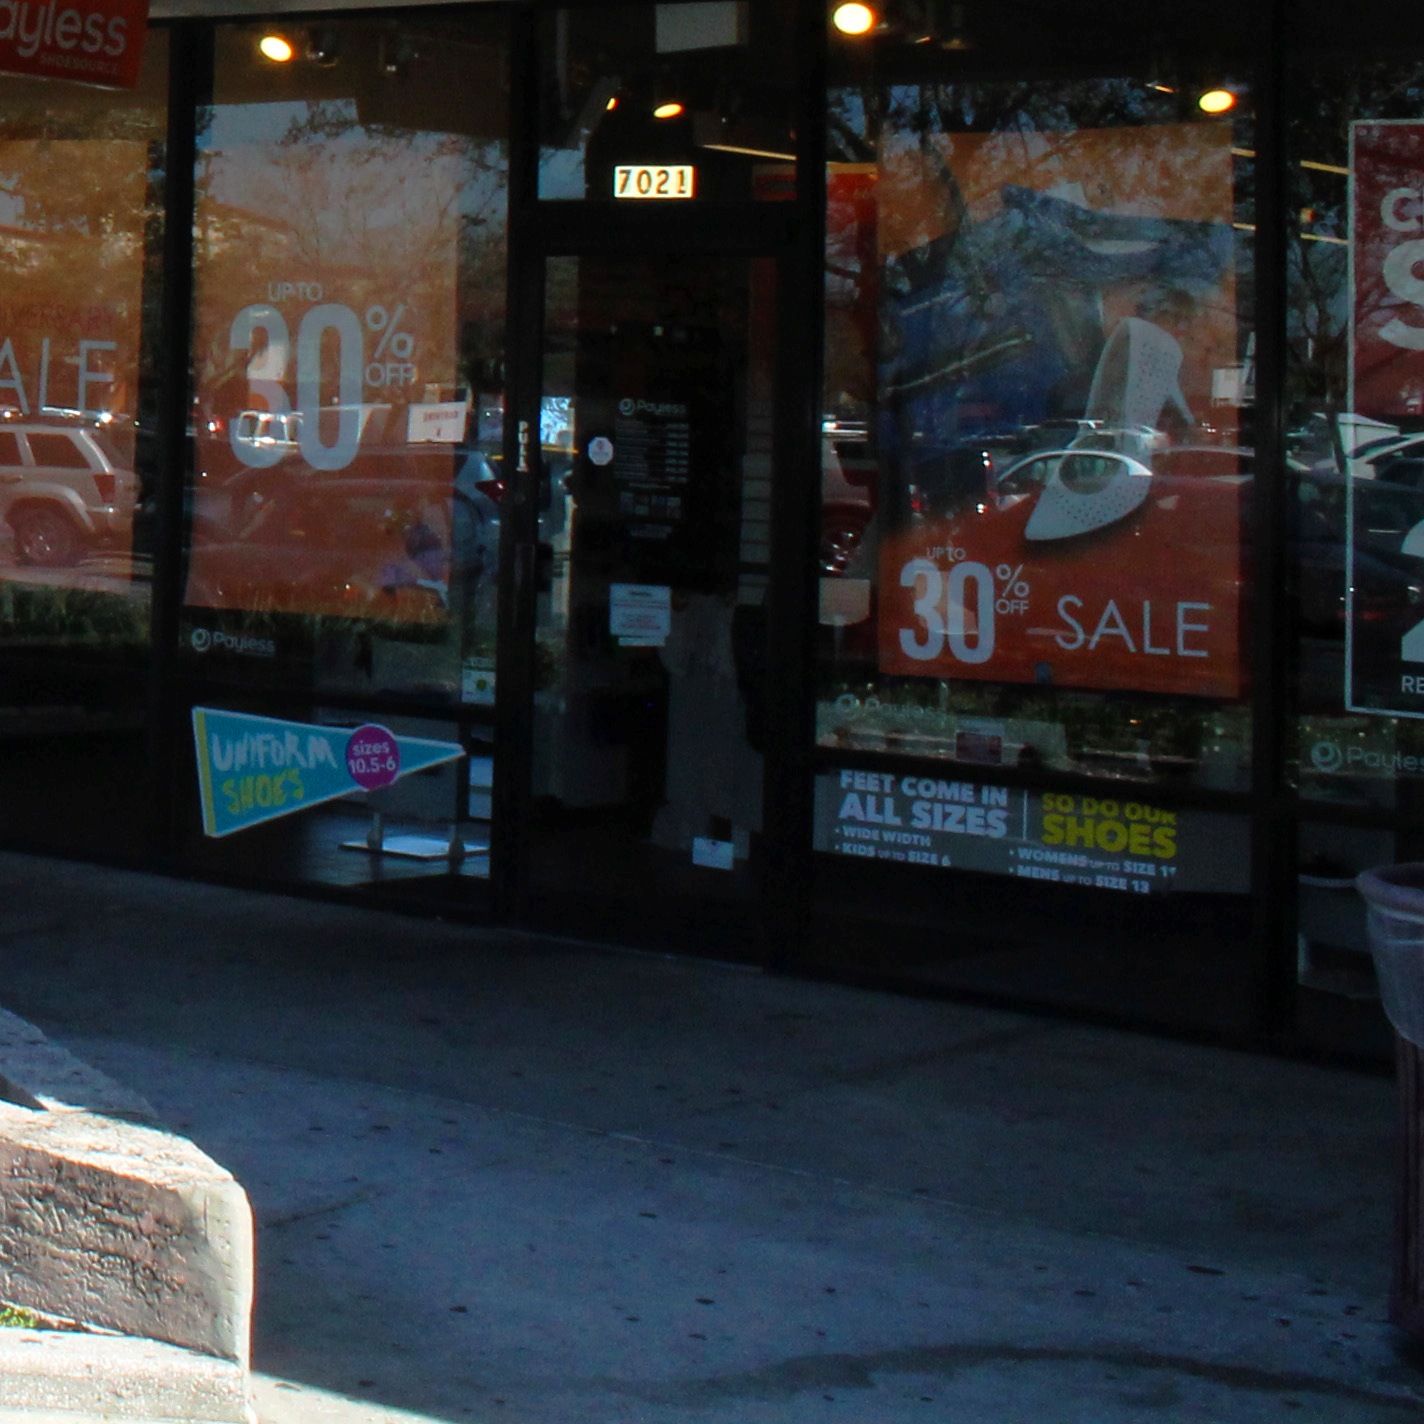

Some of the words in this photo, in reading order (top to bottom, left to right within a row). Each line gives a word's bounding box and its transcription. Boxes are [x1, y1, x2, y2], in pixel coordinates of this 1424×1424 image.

[40, 53, 119, 74] SHOESOURCE
[618, 168, 687, 195] 7021
[365, 363, 416, 387] OFF
[636, 399, 688, 416] Payless
[516, 420, 529, 473] PULL
[995, 599, 1030, 616] OFF
[1055, 594, 1212, 658] SALE
[212, 631, 276, 653] Payless
[212, 730, 338, 771] UNIFORM
[352, 740, 391, 756] sizes
[349, 756, 396, 775] 10.5-6
[222, 768, 305, 816] SHOES
[840, 768, 896, 794] FEET
[900, 776, 975, 804] COME
[981, 784, 1009, 807] IN
[839, 791, 902, 827] ALL
[910, 799, 1011, 839] SIZES
[1042, 792, 1075, 814] SO
[1082, 796, 1120, 819] DO
[1125, 801, 1177, 826] OUR
[842, 825, 880, 841] WIDE
[882, 830, 932, 848] WIDTH
[1042, 813, 1178, 860] SHOES
[842, 841, 876, 858] KIDS
[908, 850, 940, 866] SIZE
[1018, 847, 1089, 868] WOMENS
[1123, 860, 1156, 877] SIZE
[1017, 864, 1060, 882] MENS
[1095, 875, 1128, 891] SIZE
